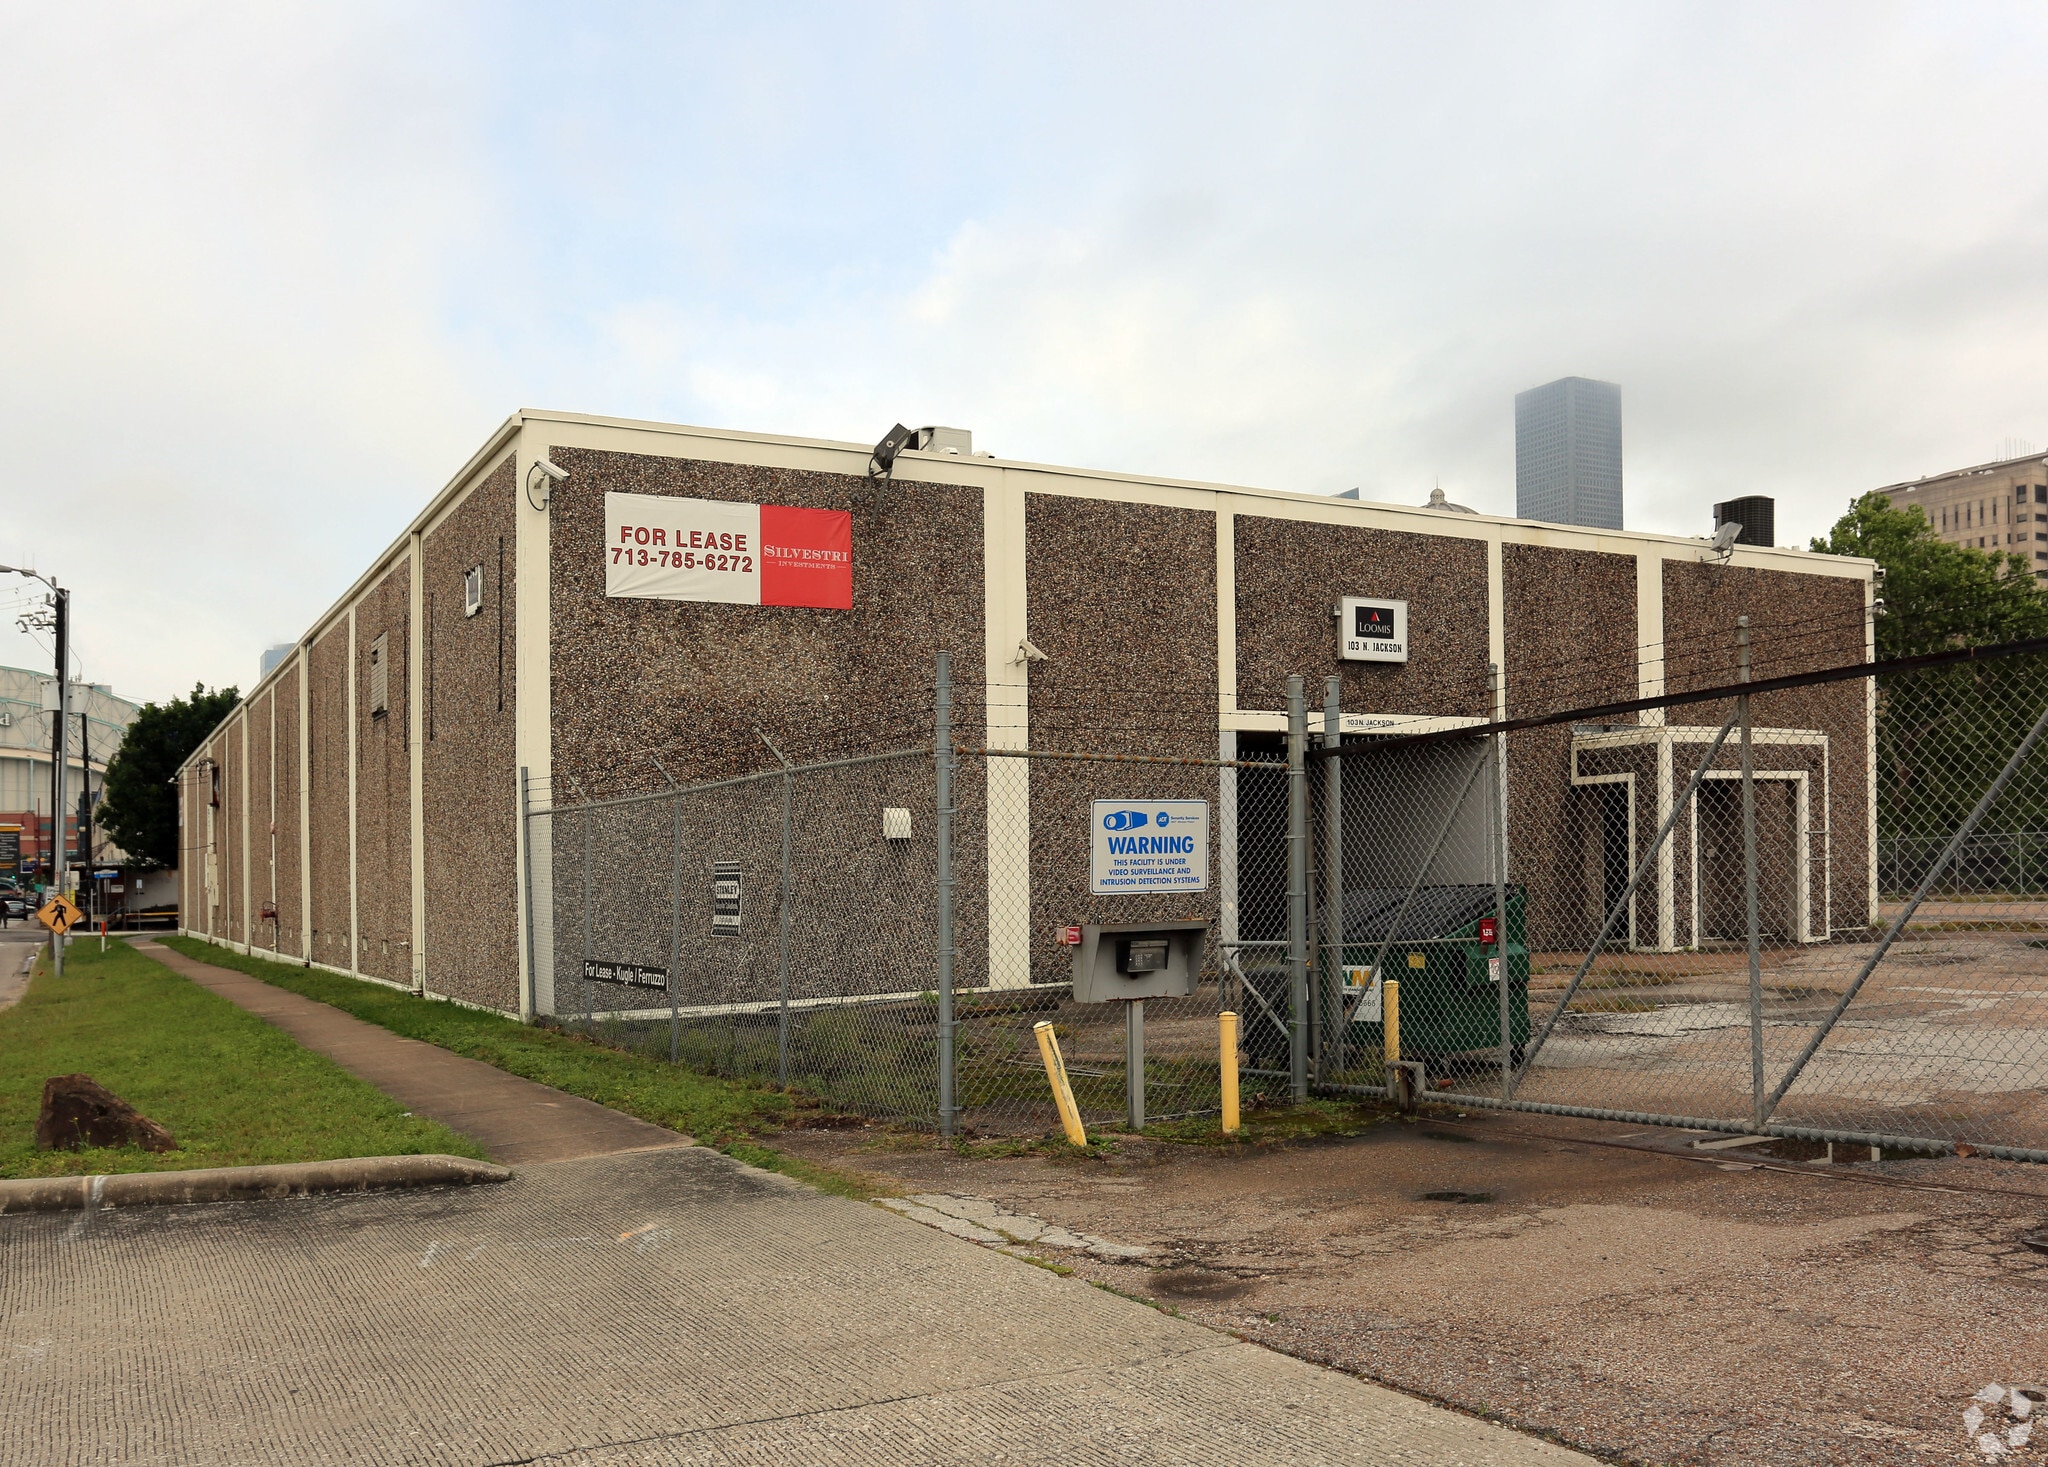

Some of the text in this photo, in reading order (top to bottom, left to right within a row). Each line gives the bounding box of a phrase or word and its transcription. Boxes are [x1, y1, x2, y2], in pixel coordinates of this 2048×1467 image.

[620, 525, 747, 551] FOR LEASE
[763, 544, 849, 562] SILVESTRI
[611, 547, 753, 573] 713-785-6272
[778, 560, 836, 570] INVESTMENTS
[1359, 621, 1391, 634] LOOMIS
[1347, 640, 1402, 653] 103 N. JACKSON
[1107, 835, 1194, 855] WARNING
[1129, 858, 1156, 866] FACILITY
[1157, 858, 1164, 866] IS
[1130, 867, 1175, 876] SURVEILLANCE
[1176, 867, 1191, 875] AND
[1099, 876, 1200, 886] INTRUSION DETECTION SYSTEMS
[584, 962, 596, 977] For
[595, 963, 612, 979] Lease
[616, 965, 634, 985] Kugle
[638, 968, 665, 986] Ferruzzo
